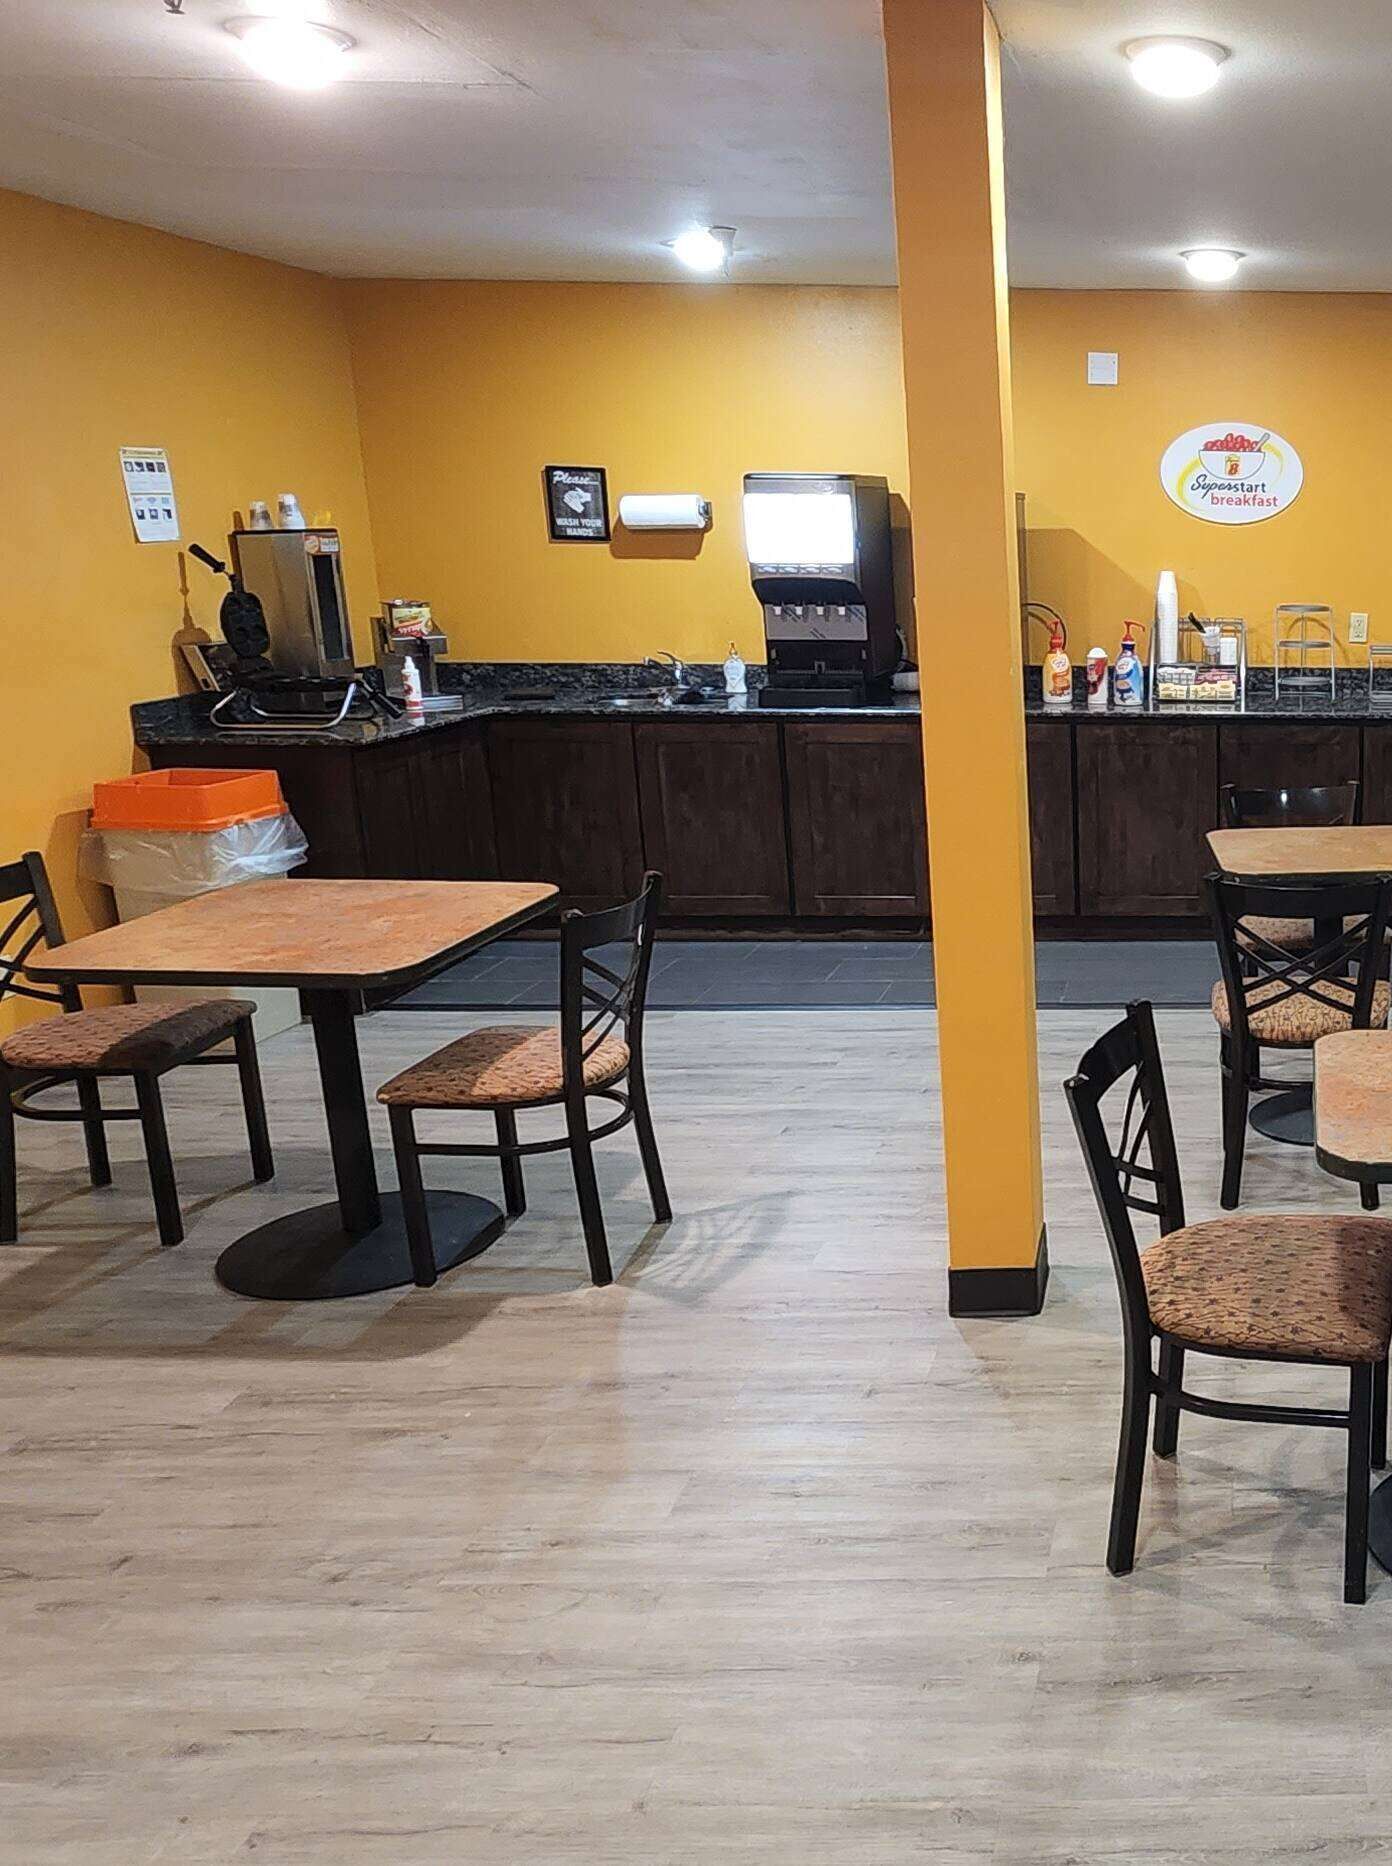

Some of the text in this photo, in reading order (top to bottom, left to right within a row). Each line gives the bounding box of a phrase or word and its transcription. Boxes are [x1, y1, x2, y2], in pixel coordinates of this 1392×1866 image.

[1190, 474, 1266, 499] Superstart
[1210, 493, 1279, 507] breakfast
[556, 518, 579, 526] WASH
